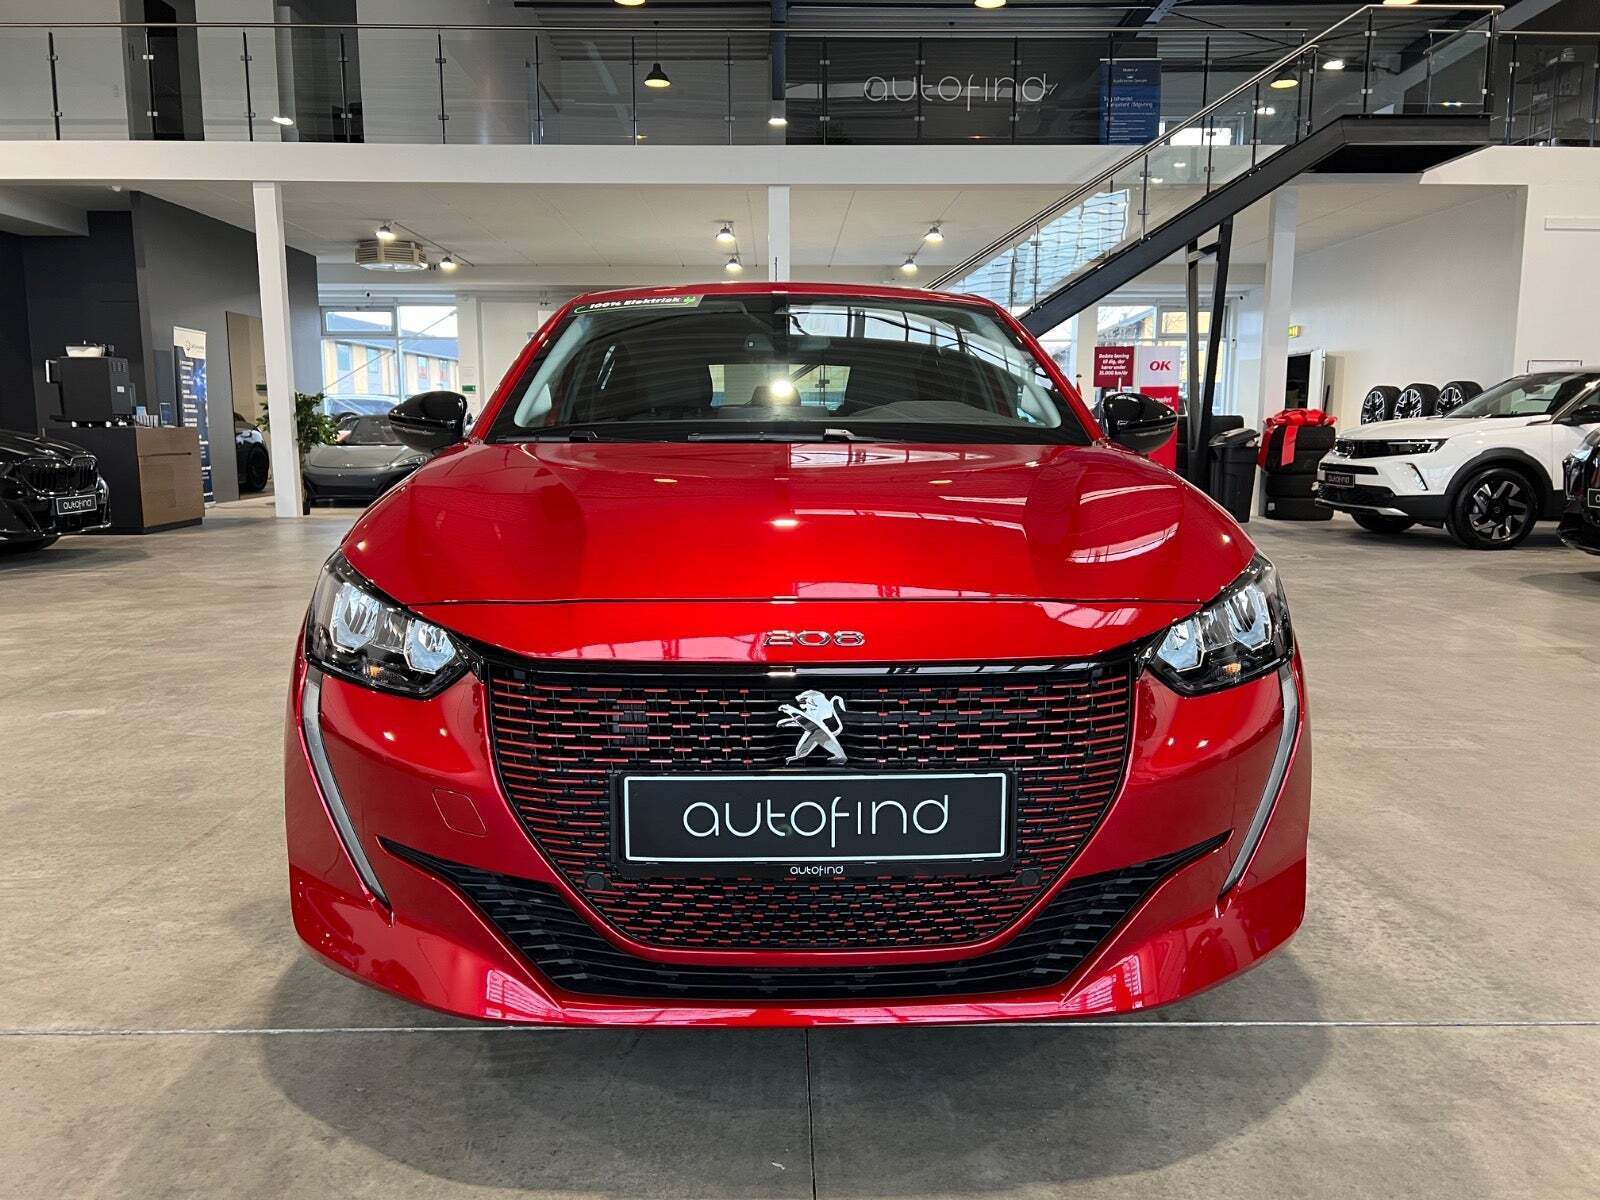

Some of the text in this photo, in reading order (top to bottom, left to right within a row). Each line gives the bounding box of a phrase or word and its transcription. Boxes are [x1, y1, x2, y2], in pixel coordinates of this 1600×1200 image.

[863, 73, 1047, 112] autofind
[589, 301, 621, 309] 100%
[1149, 360, 1172, 371] OK
[763, 629, 865, 647] 208
[683, 794, 949, 849] autofind
[789, 865, 844, 877] autofind
